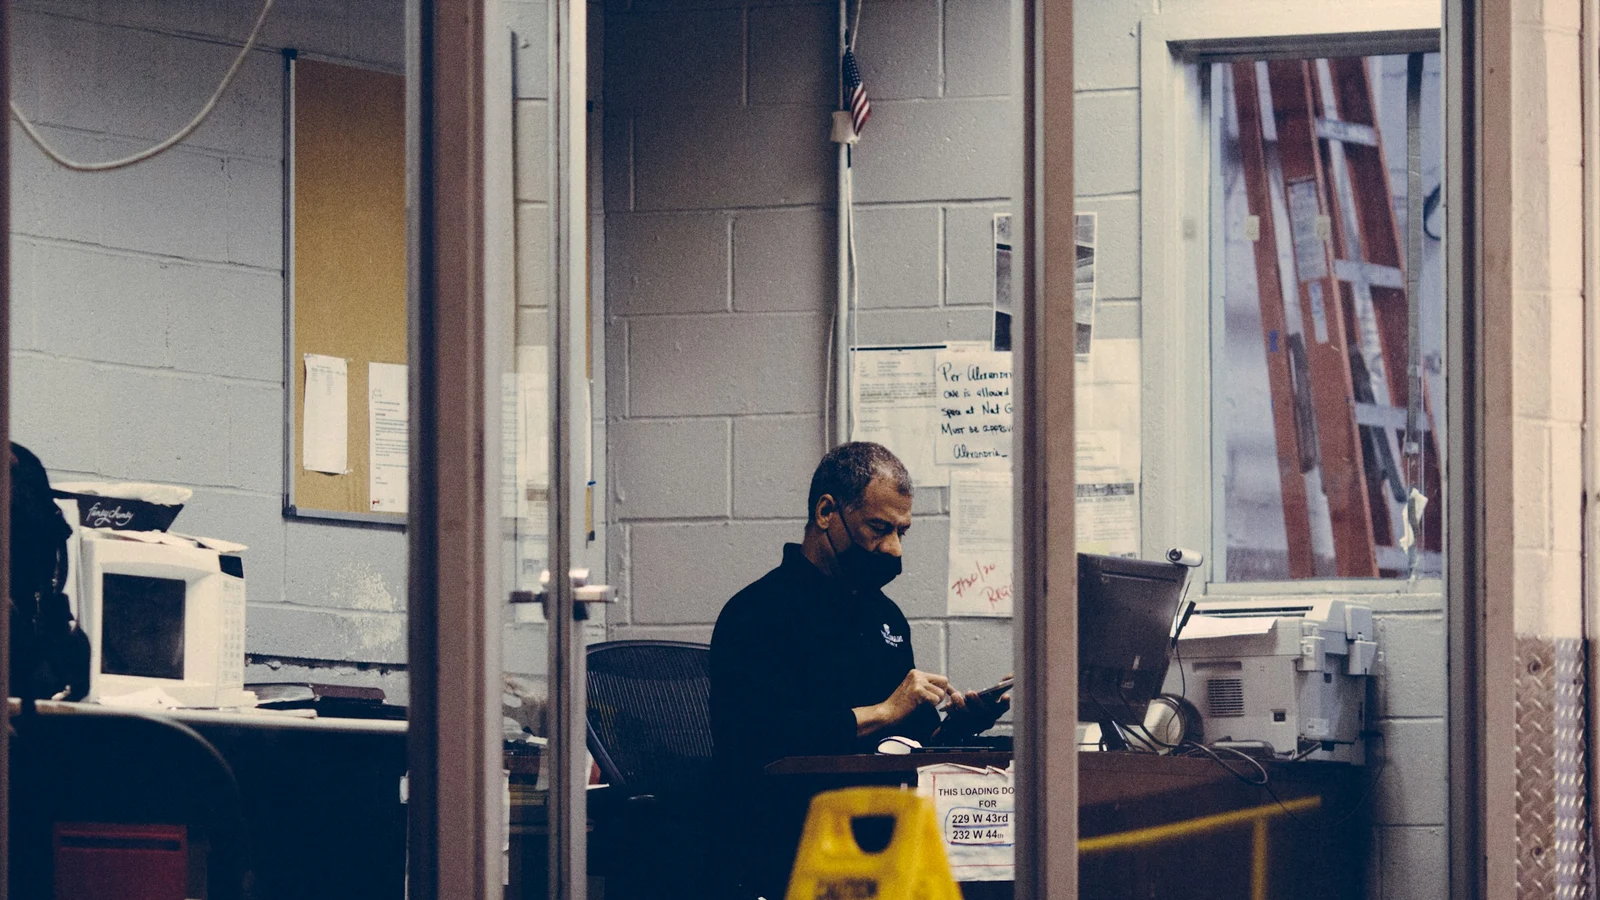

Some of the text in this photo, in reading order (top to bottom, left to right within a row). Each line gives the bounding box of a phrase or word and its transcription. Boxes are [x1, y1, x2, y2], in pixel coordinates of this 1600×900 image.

[937, 362, 960, 381] Per
[964, 388, 971, 398] is
[977, 387, 1009, 398] allowed
[966, 406, 974, 415] at
[982, 401, 999, 415] Nat
[938, 788, 958, 796] THIS
[960, 787, 999, 795] LOADING
[978, 800, 997, 808] FOR
[952, 813, 1009, 824] 229 W 43rd
[952, 829, 1004, 840] 232 W 44th
